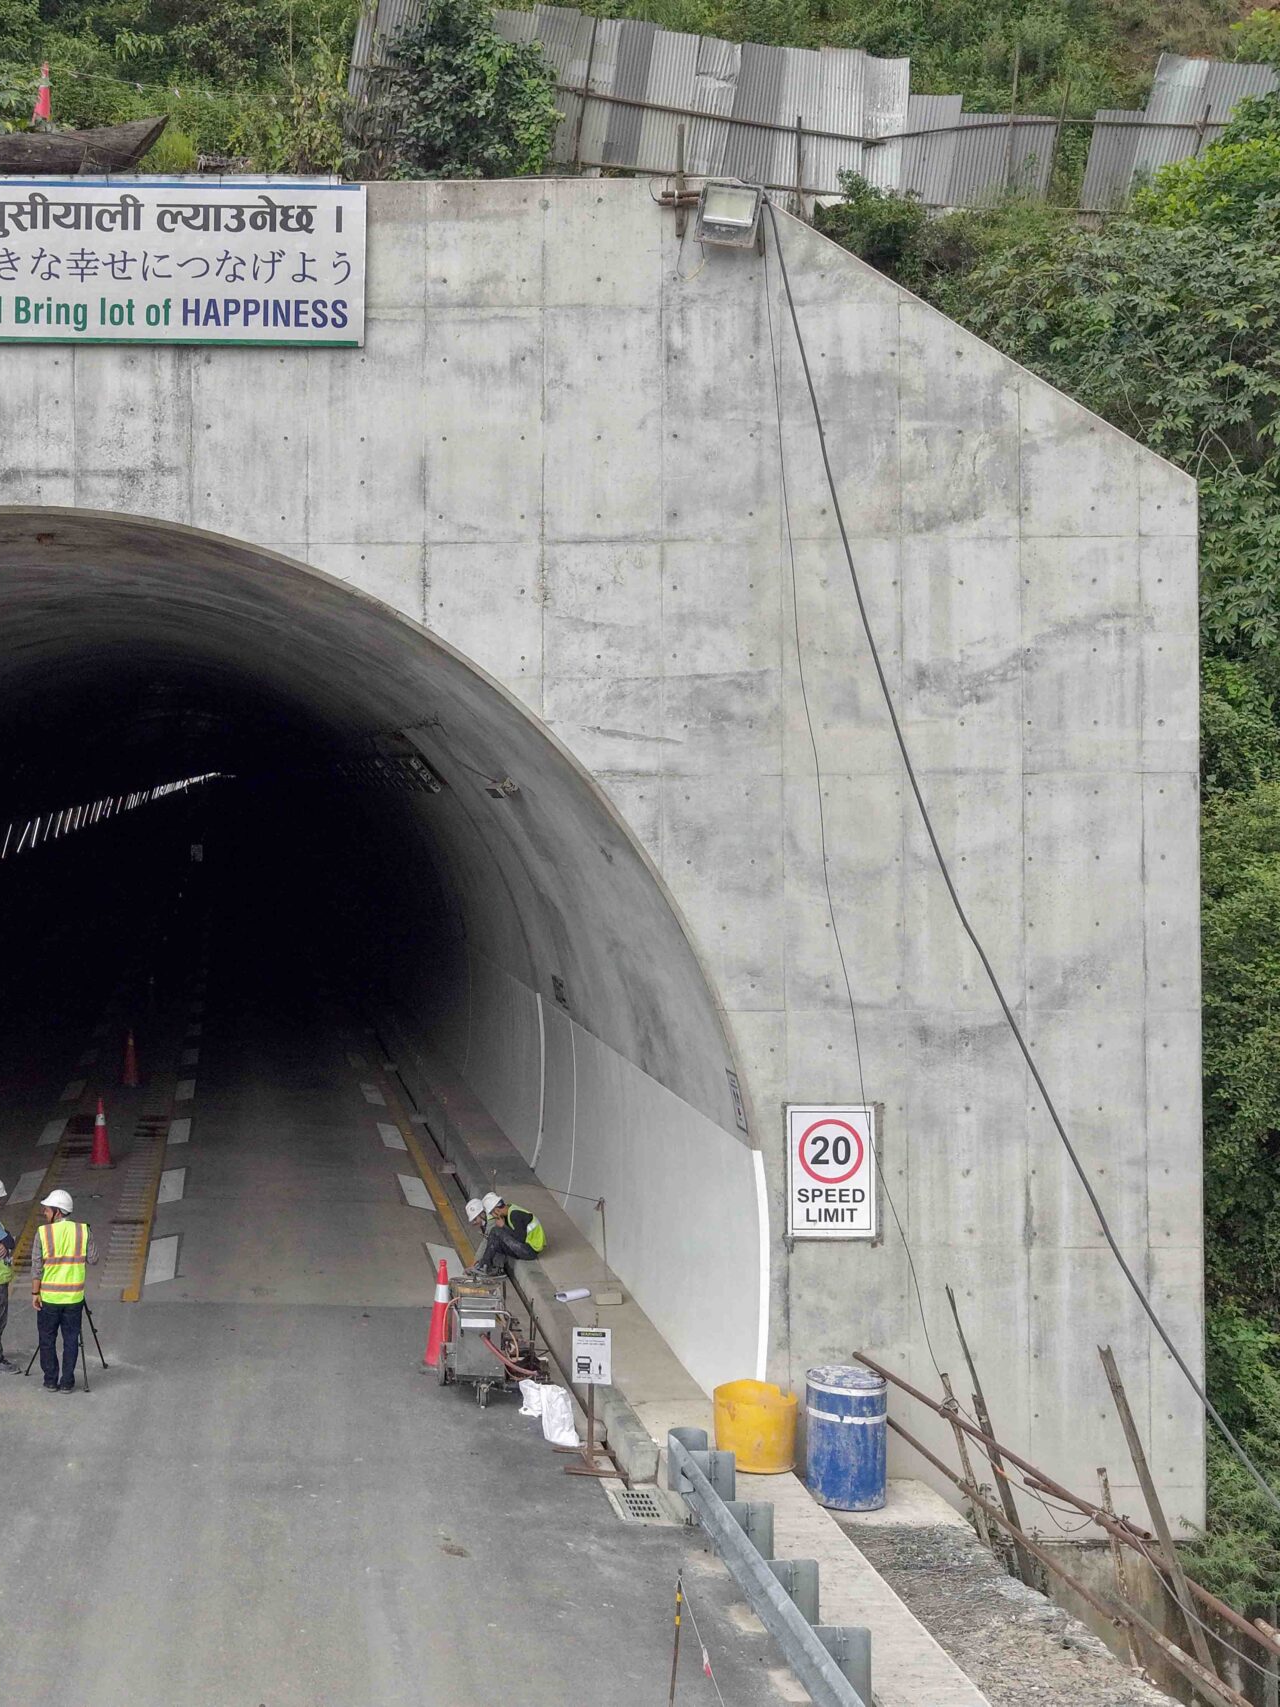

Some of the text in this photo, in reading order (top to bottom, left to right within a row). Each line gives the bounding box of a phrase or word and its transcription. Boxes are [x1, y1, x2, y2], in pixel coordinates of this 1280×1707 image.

[156, 195, 317, 234] ल्याउनेछ
[14, 296, 88, 332] Bring
[100, 298, 135, 326] lot
[145, 299, 172, 327] of
[182, 298, 348, 329] HAPPINESS
[810, 1136, 851, 1165] 20
[797, 1188, 865, 1203] SPEED
[806, 1208, 858, 1223] LIMIT
